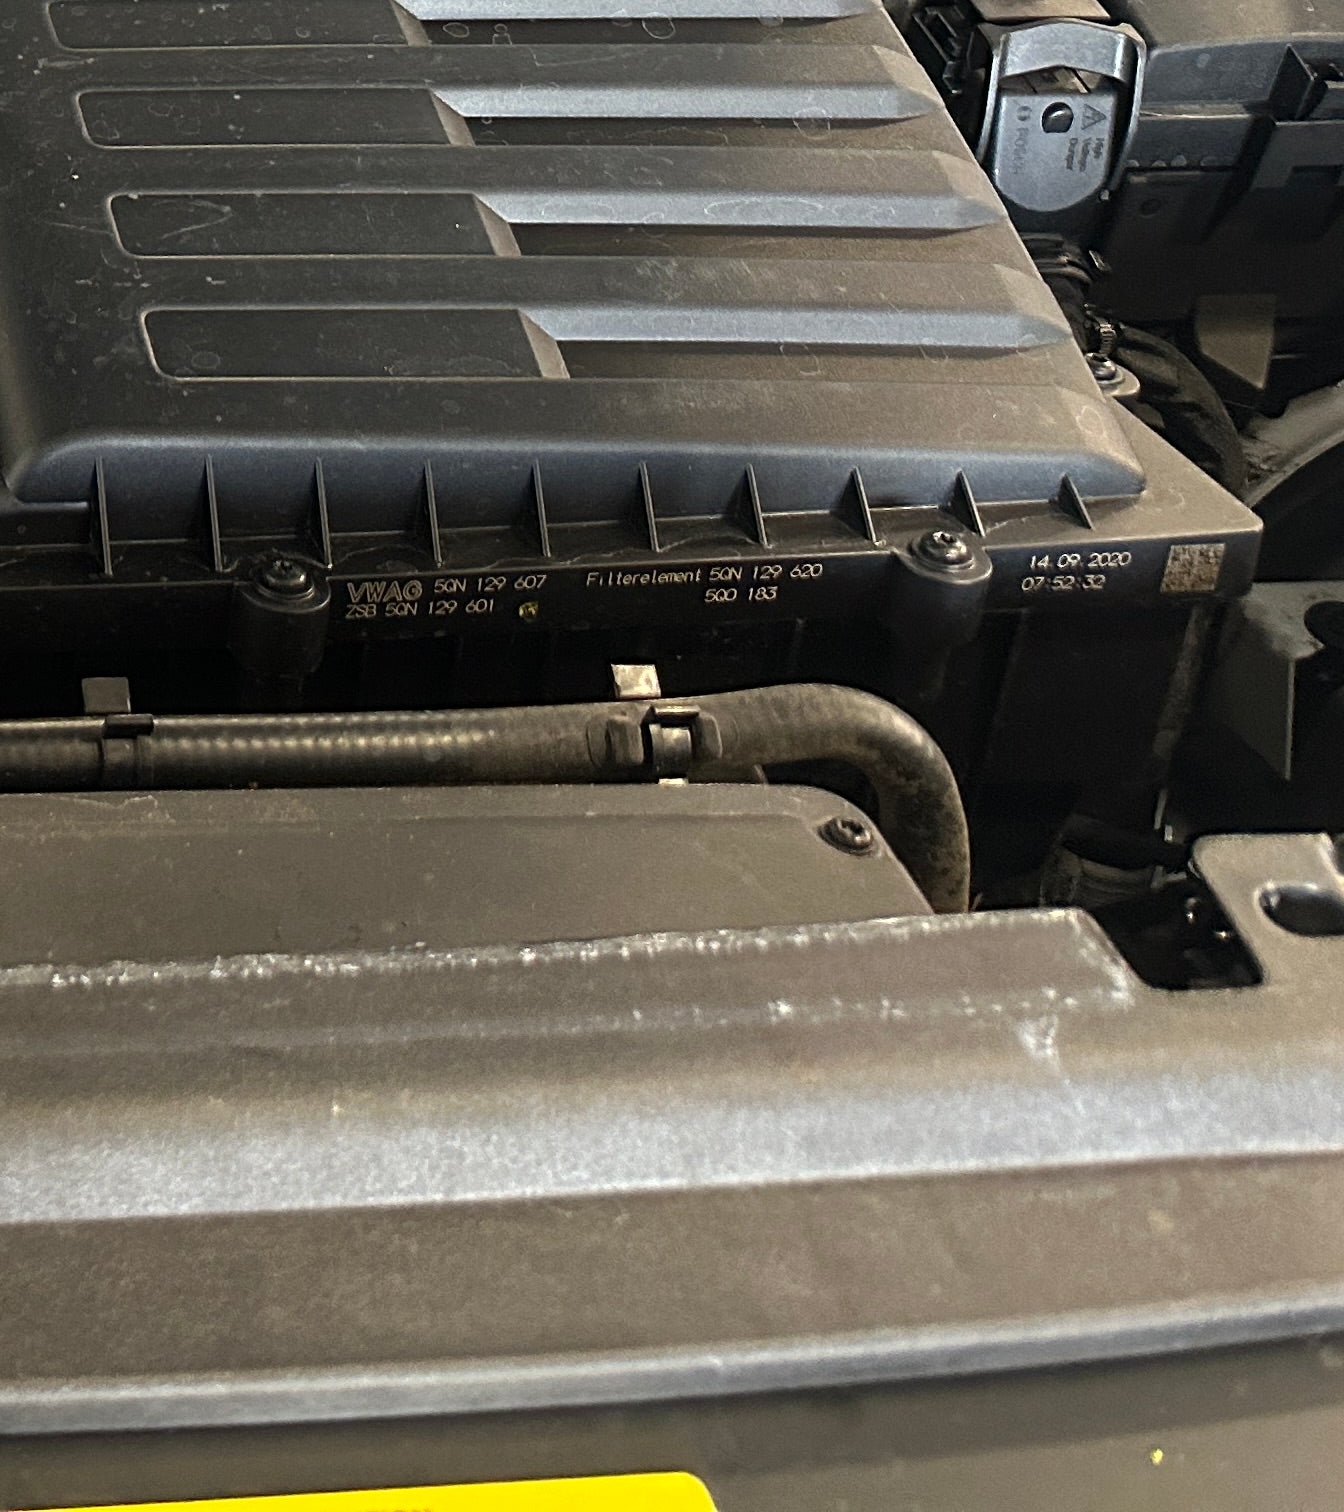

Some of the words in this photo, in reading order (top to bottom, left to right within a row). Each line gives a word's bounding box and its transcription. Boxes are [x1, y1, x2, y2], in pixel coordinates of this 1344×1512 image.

[586, 568, 702, 587] Filterelement
[753, 564, 783, 581] 129
[790, 563, 823, 579] 620
[346, 580, 423, 604] VWAG
[477, 576, 507, 592] 129
[514, 574, 547, 590] 607
[748, 585, 778, 601] 183
[345, 603, 377, 619] ZSB
[428, 600, 458, 616] 129
[465, 598, 495, 614] 601
